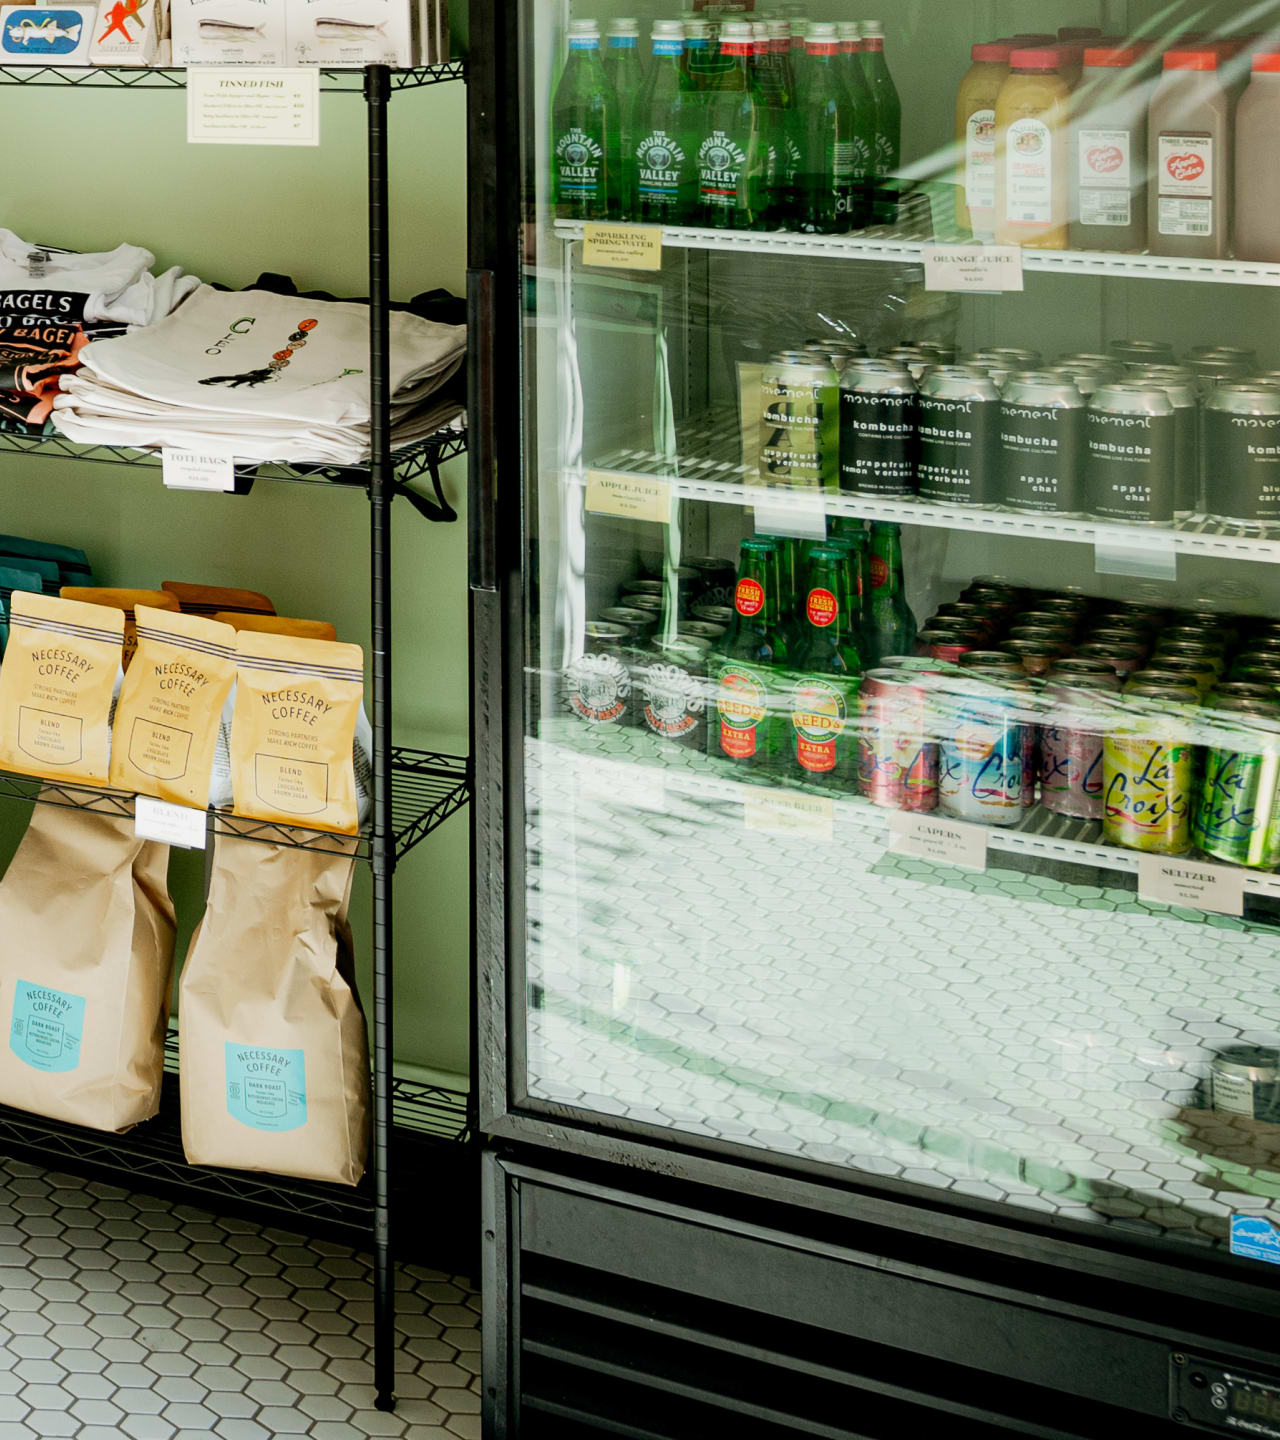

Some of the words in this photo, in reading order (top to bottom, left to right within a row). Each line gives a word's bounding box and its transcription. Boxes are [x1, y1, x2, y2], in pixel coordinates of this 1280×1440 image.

[218, 80, 257, 88] TINNED
[259, 80, 284, 88] FISH
[555, 133, 604, 159] MOUNTAIN
[635, 135, 686, 162] MOUNTAIN
[699, 136, 746, 164] MOUNTAIN
[559, 167, 598, 178] VALLEY
[639, 169, 679, 181] VALLEY
[701, 169, 738, 183] VALLEY
[595, 231, 647, 241] SPARKLING
[933, 254, 980, 264] ORANGE
[981, 254, 1014, 264] JUICE
[852, 419, 914, 434] kombucha
[31, 647, 95, 674] NECESSARY
[38, 664, 81, 685] COFFEE
[154, 663, 210, 689] NECESSARY
[159, 678, 197, 698] COFFEE
[261, 690, 333, 715] NECESSARY
[271, 706, 319, 727] COFFEE
[793, 713, 842, 731] REED'S
[800, 742, 831, 755] EXTRA
[279, 766, 304, 777] BLEND
[1105, 772, 1188, 824] Croix
[916, 824, 962, 841] CAPERS
[1160, 867, 1217, 885] SELTZER
